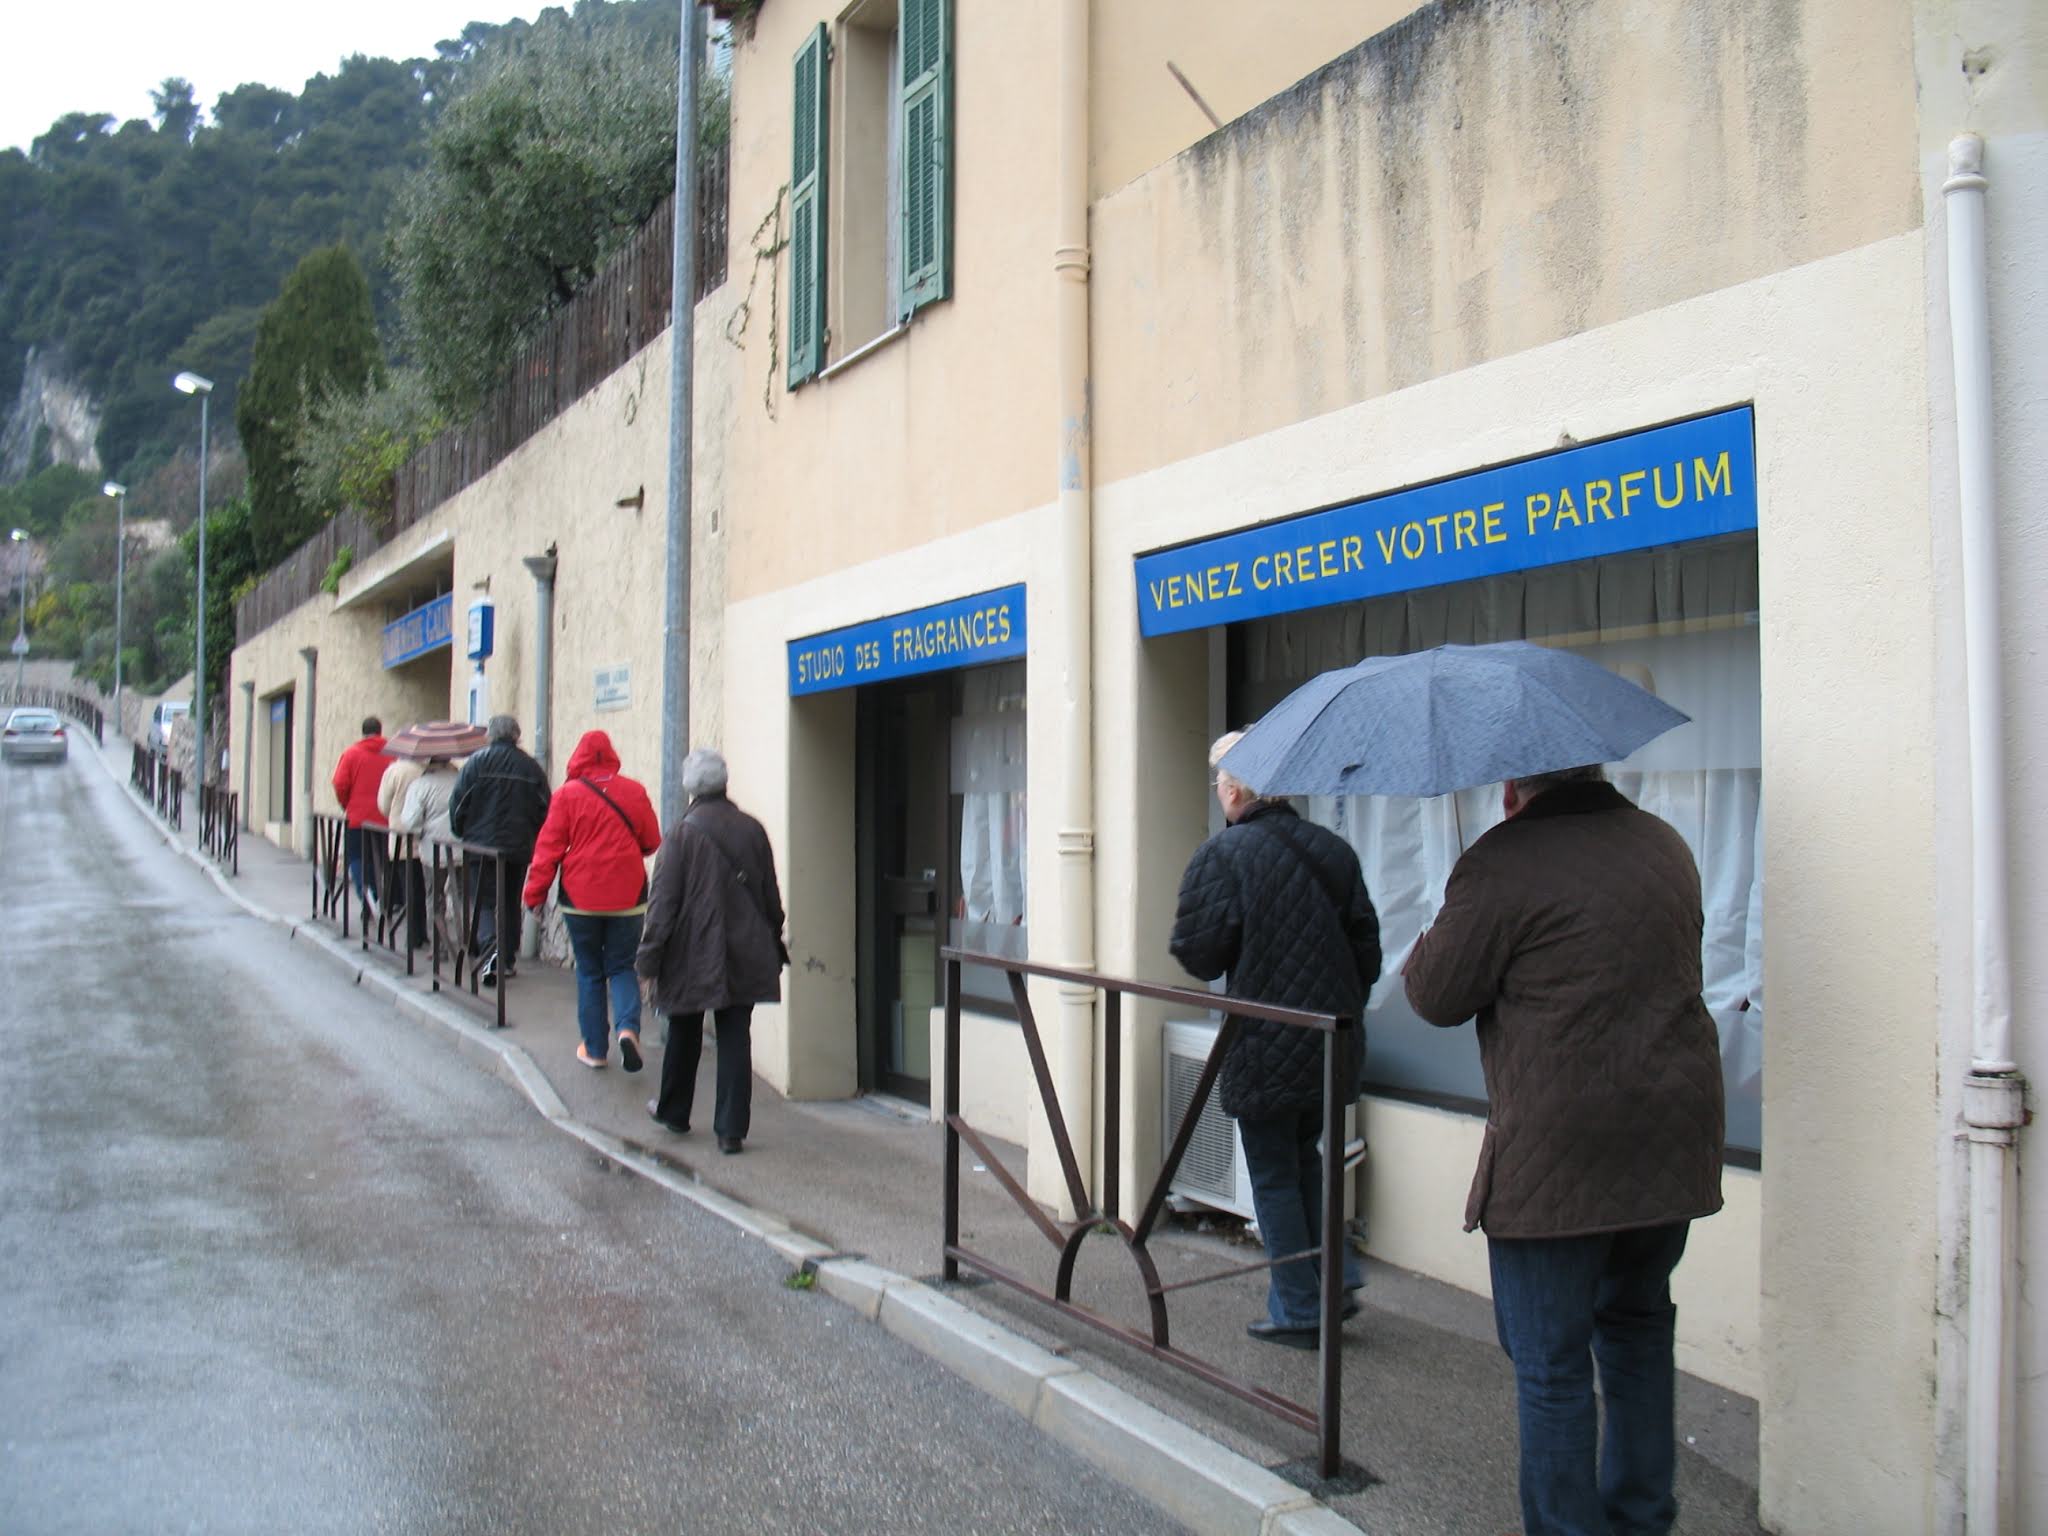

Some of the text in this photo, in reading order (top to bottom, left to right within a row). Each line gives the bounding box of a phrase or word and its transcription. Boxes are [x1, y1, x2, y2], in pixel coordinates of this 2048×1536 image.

[1150, 451, 1733, 611] VENEZ CREER VOTRE PARFUM
[798, 605, 1011, 683] STUDIO DES FRAGRANCES
